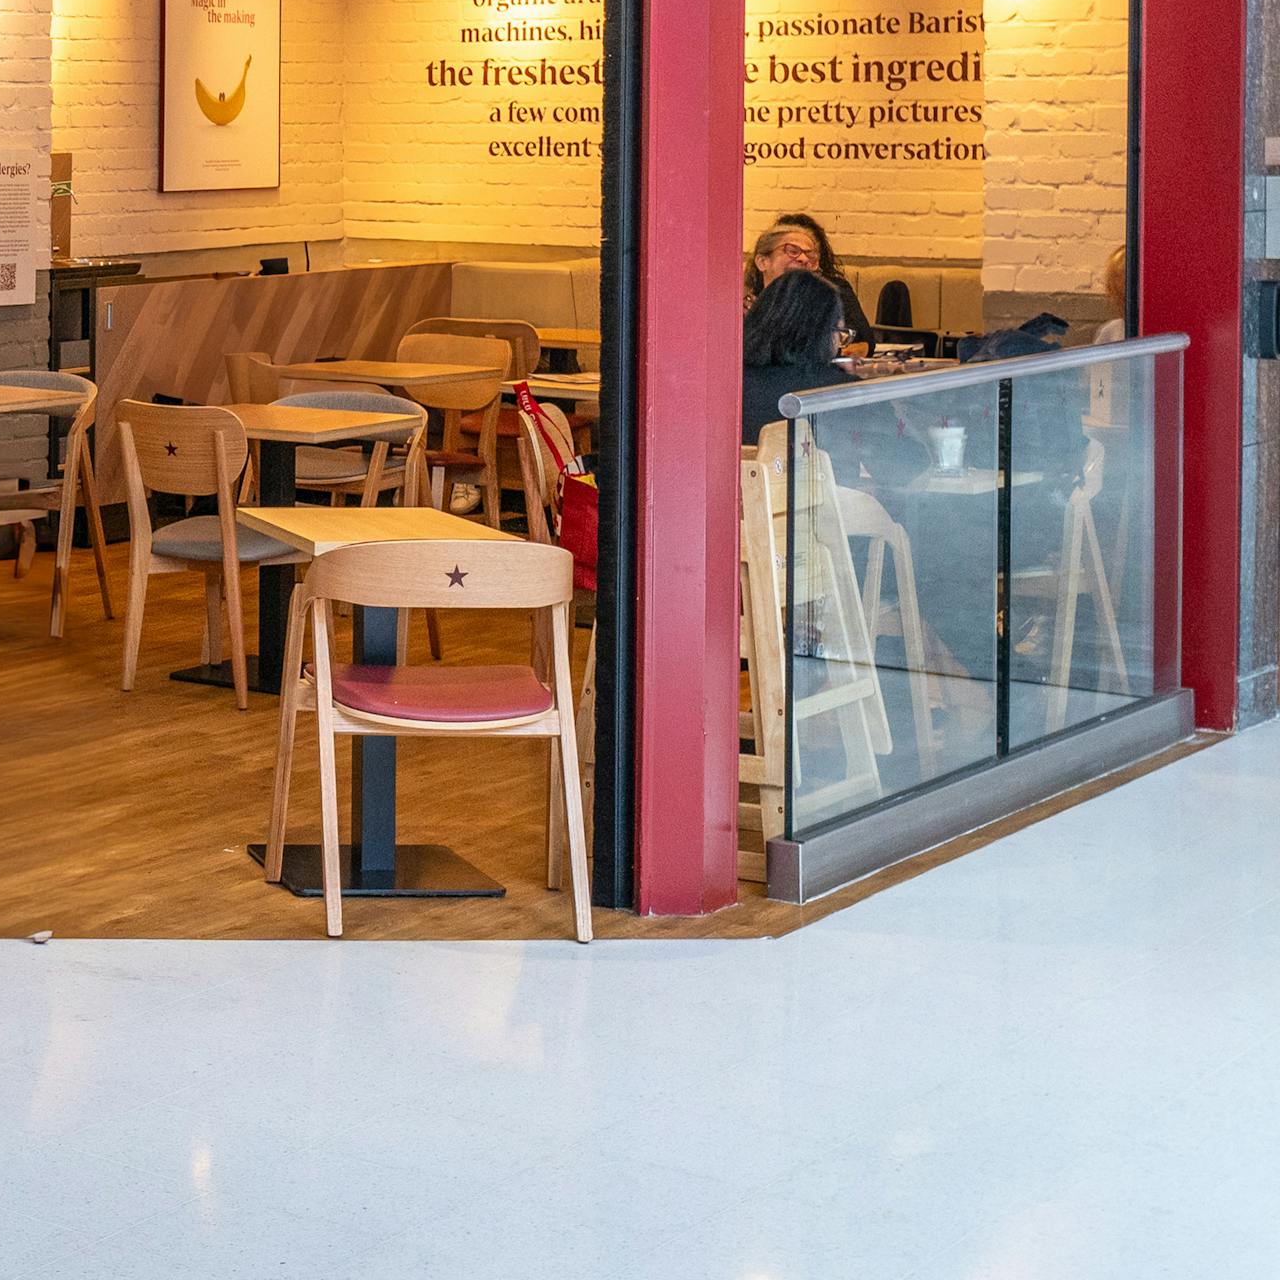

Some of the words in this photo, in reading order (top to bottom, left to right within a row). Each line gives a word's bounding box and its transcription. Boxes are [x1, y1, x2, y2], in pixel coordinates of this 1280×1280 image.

[208, 9, 222, 23] the
[224, 10, 255, 28] making
[759, 13, 900, 42] passionate
[426, 60, 473, 86] the
[482, 58, 604, 86] freshest
[769, 55, 842, 84] best
[852, 51, 982, 91] ingredi
[490, 106, 501, 122] a
[508, 101, 546, 123] few
[777, 101, 861, 128] pretty
[869, 100, 982, 128] pictures
[489, 136, 592, 157] excellent
[744, 137, 805, 165] good
[813, 137, 986, 161] conversation
